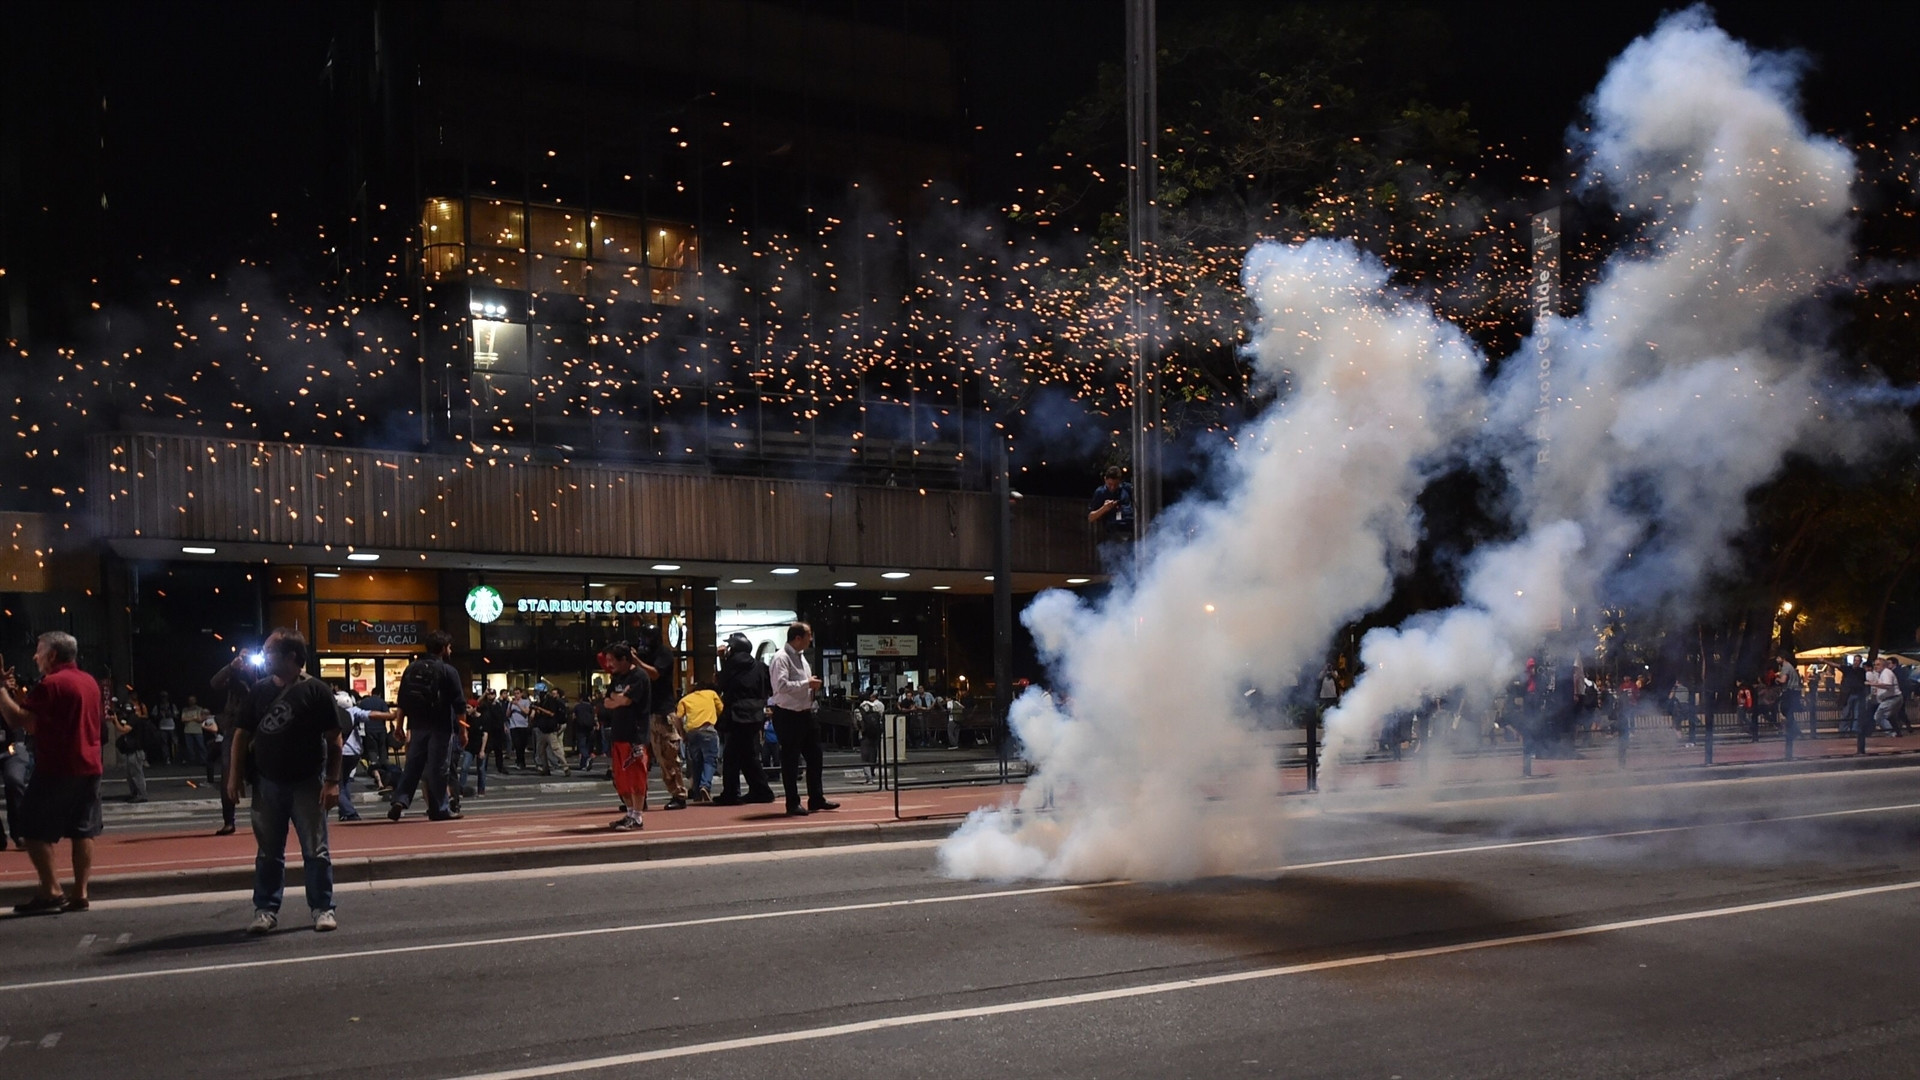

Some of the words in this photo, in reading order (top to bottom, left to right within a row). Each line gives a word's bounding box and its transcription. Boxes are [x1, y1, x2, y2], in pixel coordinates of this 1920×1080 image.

[1537, 358, 1551, 440] Peixoto
[518, 599, 612, 613] STARBUCKS
[615, 601, 672, 614] COFFEE
[340, 624, 417, 633] CHCOLATES
[377, 634, 417, 645] CACAU
